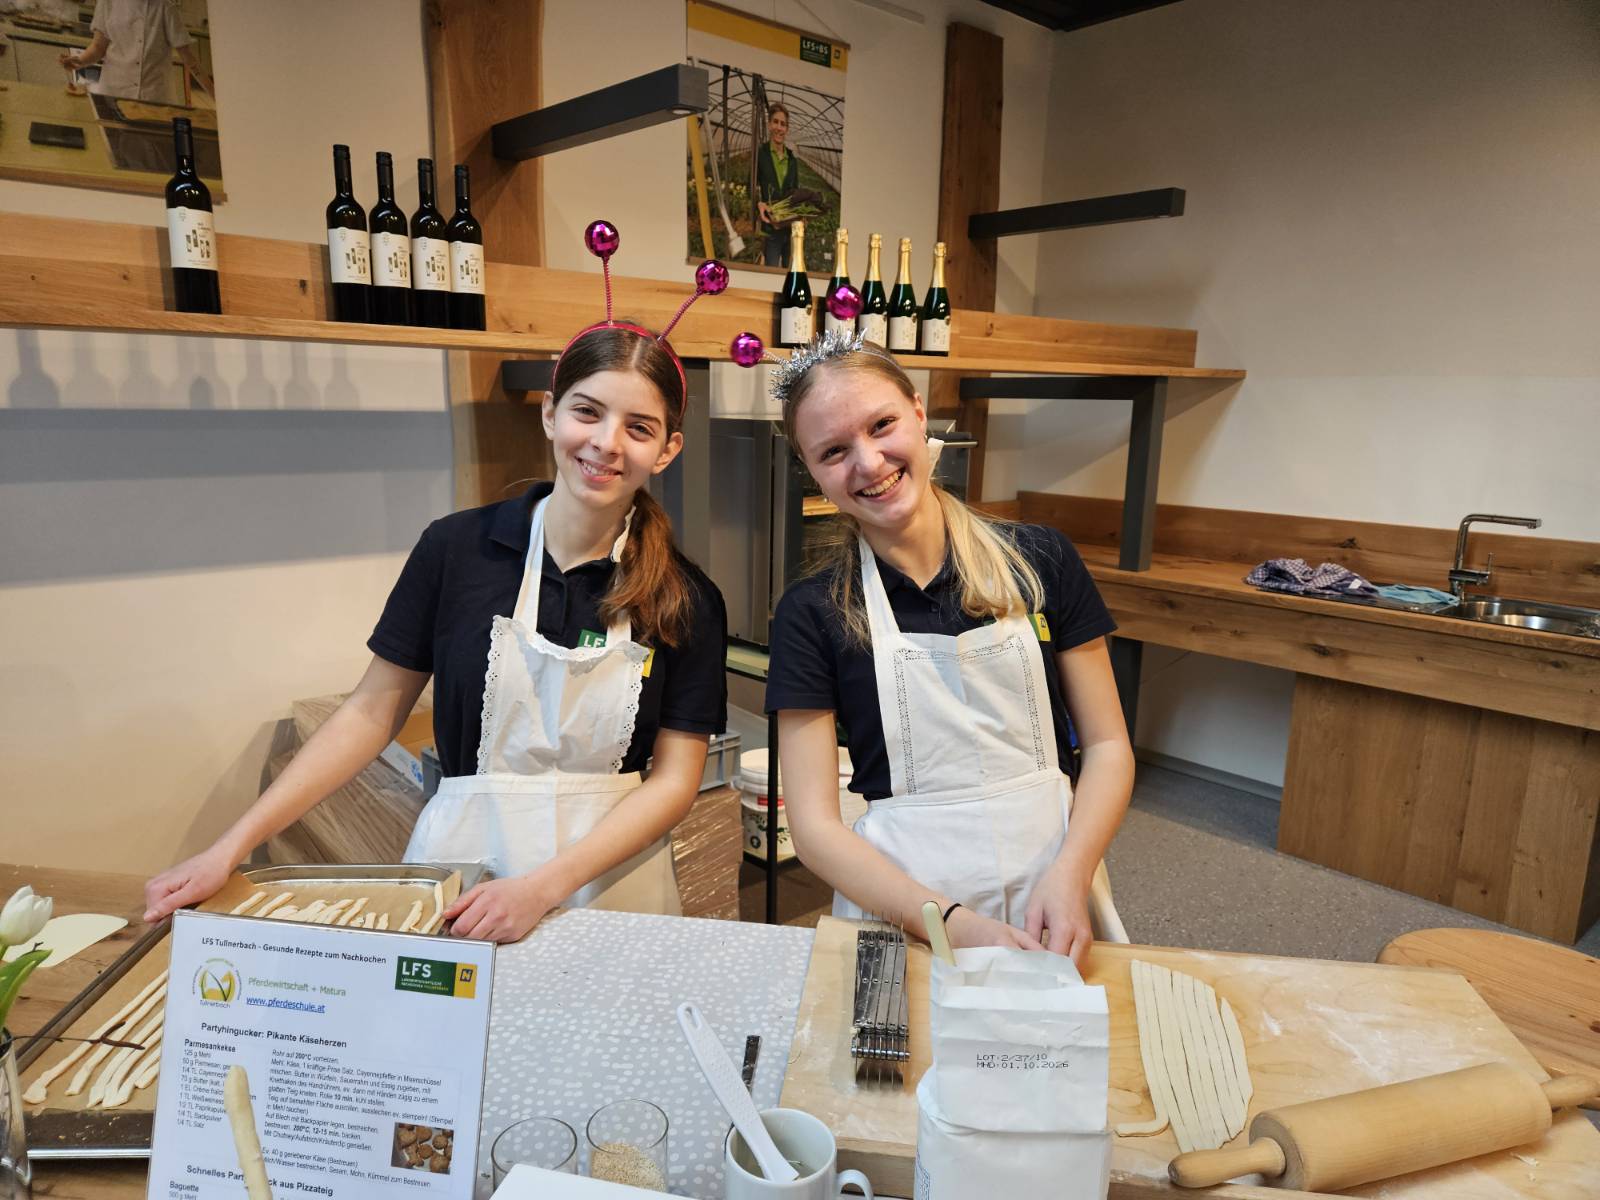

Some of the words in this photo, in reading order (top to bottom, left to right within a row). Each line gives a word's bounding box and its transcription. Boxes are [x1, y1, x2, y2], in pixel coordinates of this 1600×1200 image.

[584, 635, 606, 648] LF
[202, 937, 214, 945] LFS
[215, 939, 256, 950] Tullnerbach
[263, 944, 294, 954] Gesunde
[295, 946, 323, 958] Rezepte
[342, 952, 386, 964] Nachkochen
[402, 961, 431, 978] LFS
[248, 977, 309, 992] Pferdewirtschaft
[320, 986, 346, 996] Matura
[246, 997, 325, 1013] www.pferdeschule.at
[201, 1022, 264, 1038] Partyhingucker:
[266, 1030, 297, 1042] Pikante
[299, 1034, 347, 1048] Käseherzen
[184, 1039, 236, 1052] Parmesankekse
[295, 1052, 311, 1060] 200°C
[170, 1181, 199, 1193] Baguette
[186, 1165, 225, 1178] Schnelles
[280, 1181, 294, 1190] aus
[297, 1182, 333, 1197] Pizzateig
